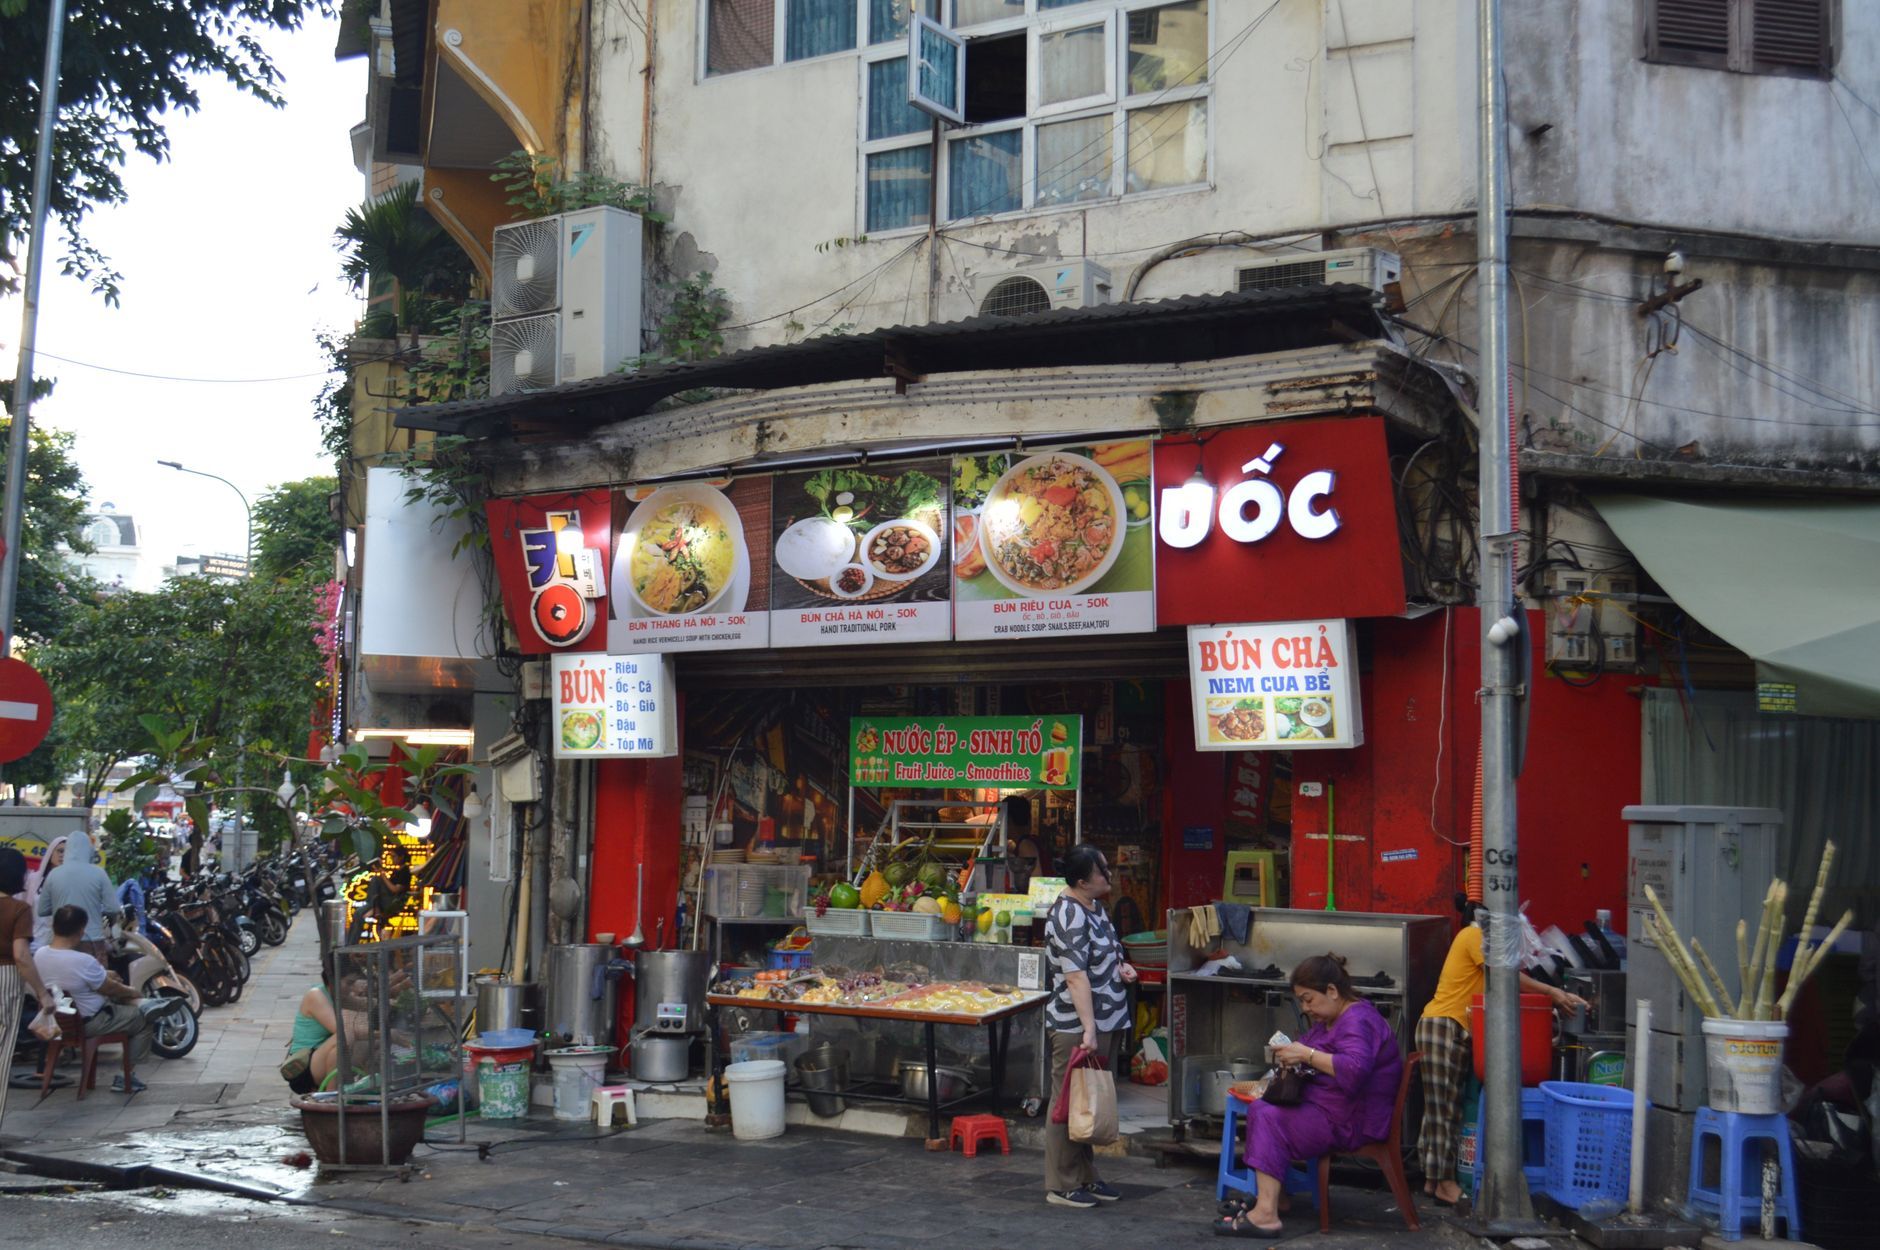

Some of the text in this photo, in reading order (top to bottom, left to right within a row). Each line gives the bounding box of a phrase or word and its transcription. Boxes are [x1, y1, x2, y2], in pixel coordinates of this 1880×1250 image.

[994, 601, 1016, 613] BÚN
[1020, 600, 1044, 612] RIÊU
[1049, 600, 1072, 610] CUA
[1087, 598, 1109, 608] 50K
[628, 618, 648, 631] BÚN
[652, 619, 681, 630] THANG
[684, 616, 697, 628] HÀ
[700, 615, 716, 628] NỘI
[728, 615, 746, 626] 50K
[801, 611, 821, 623] BÚN
[825, 608, 845, 622] CHẢ
[848, 608, 863, 620] HÀ
[867, 607, 884, 621] NỘI
[897, 608, 918, 618] 50K
[820, 621, 896, 635] HANOI TRADITIONAL PORK
[994, 624, 1009, 634] CRAB
[1009, 623, 1030, 633] NOODLE
[1198, 625, 1338, 672] BÚN CHẢ
[615, 662, 638, 674] Riêu
[560, 659, 606, 704] BÚN
[615, 677, 629, 693] Ốc
[1208, 668, 1331, 694] NEM CUA BỂ
[616, 700, 629, 712] Bò
[617, 719, 636, 734] Đậu
[617, 738, 635, 751] Tóp
[883, 722, 931, 754] NƯỚC
[935, 723, 957, 754] ÉP
[970, 729, 1014, 754] SINH
[1017, 718, 1043, 755] TỐ
[895, 762, 923, 780] Fruit
[924, 762, 954, 780] Juice
[967, 762, 1031, 781] Smoothies
